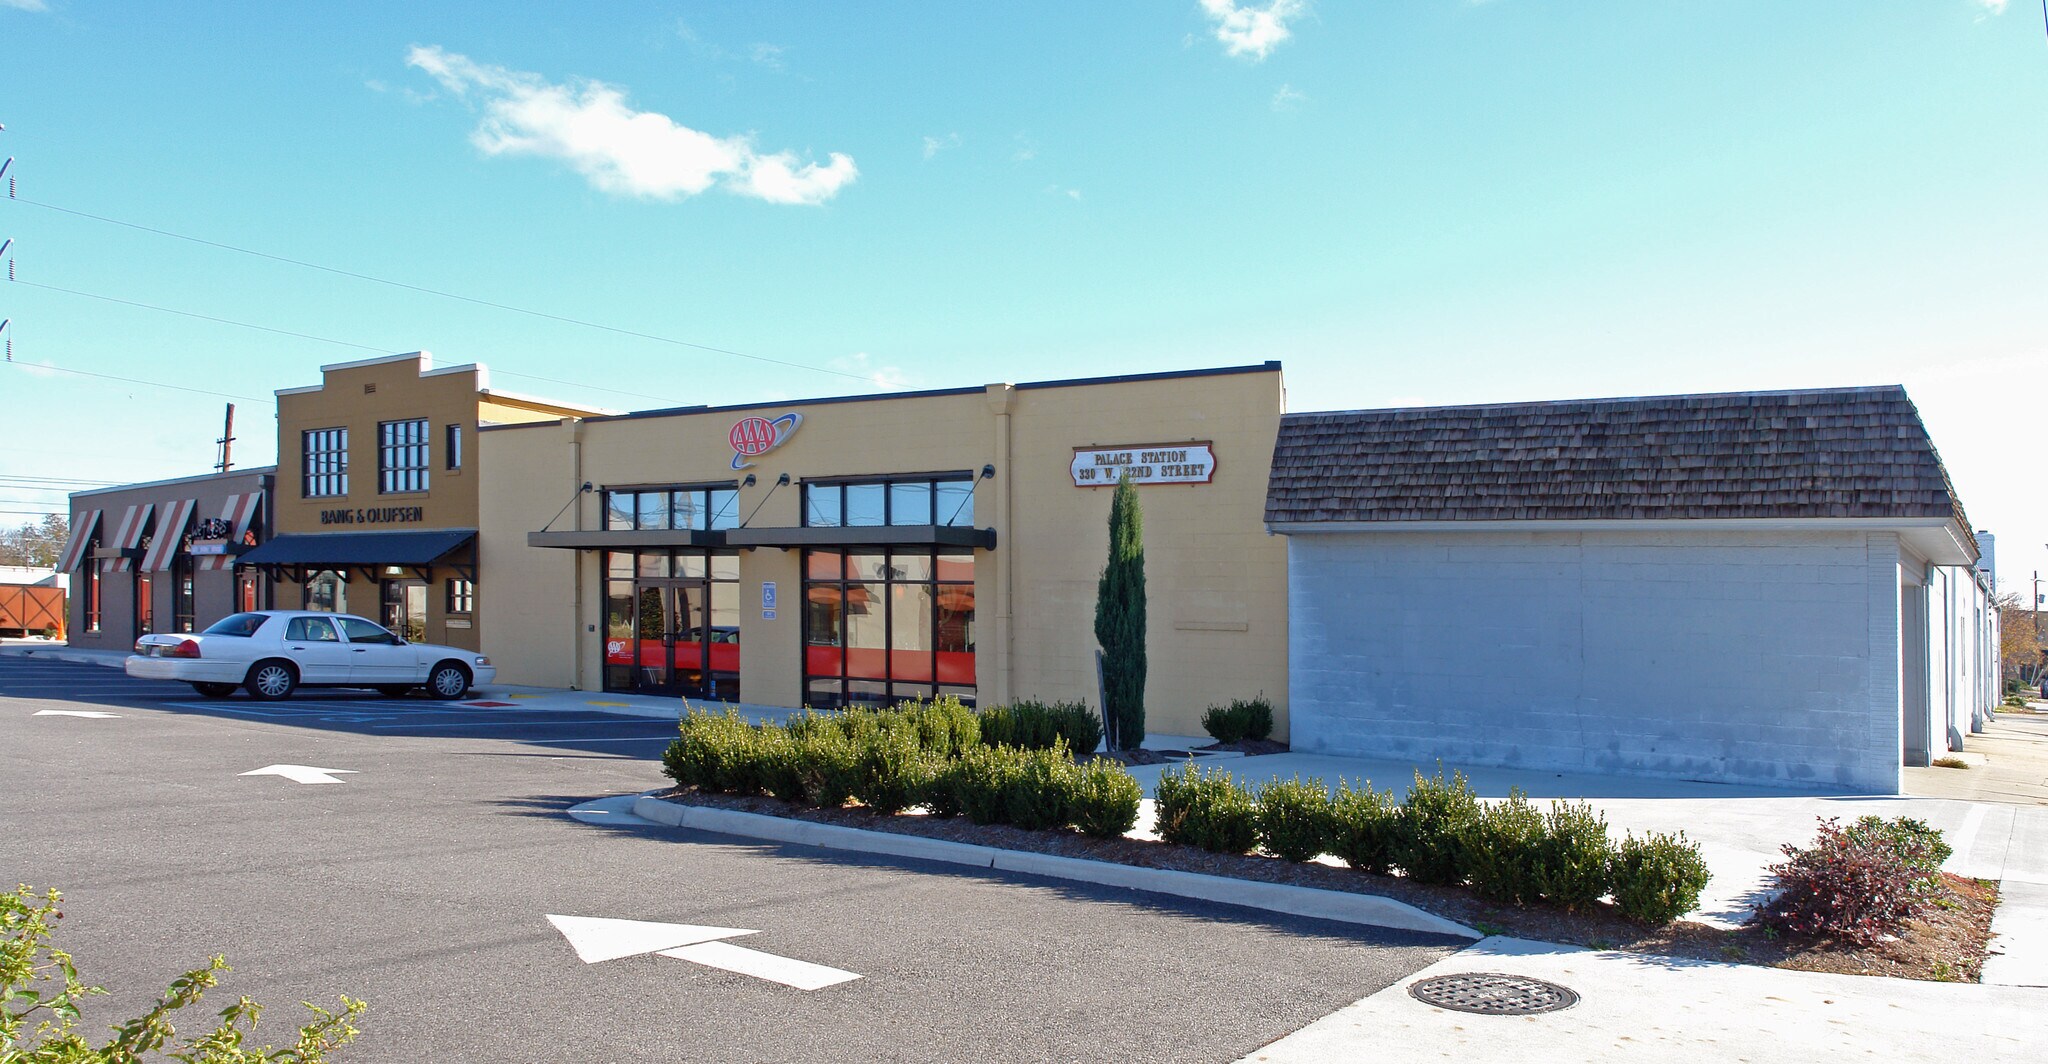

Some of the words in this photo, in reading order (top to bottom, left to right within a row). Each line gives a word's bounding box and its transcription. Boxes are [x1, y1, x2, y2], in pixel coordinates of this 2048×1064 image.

[731, 419, 774, 453] AAA
[1095, 453, 1132, 465] PALACE
[1141, 451, 1187, 463] STATION
[1079, 469, 1095, 479] 330
[1104, 468, 1116, 479] W.
[1124, 466, 1152, 477] 22ND
[1161, 464, 1204, 476] STREET
[321, 509, 353, 524] BANG
[356, 509, 364, 523] &
[367, 507, 422, 523] OLUFSEN
